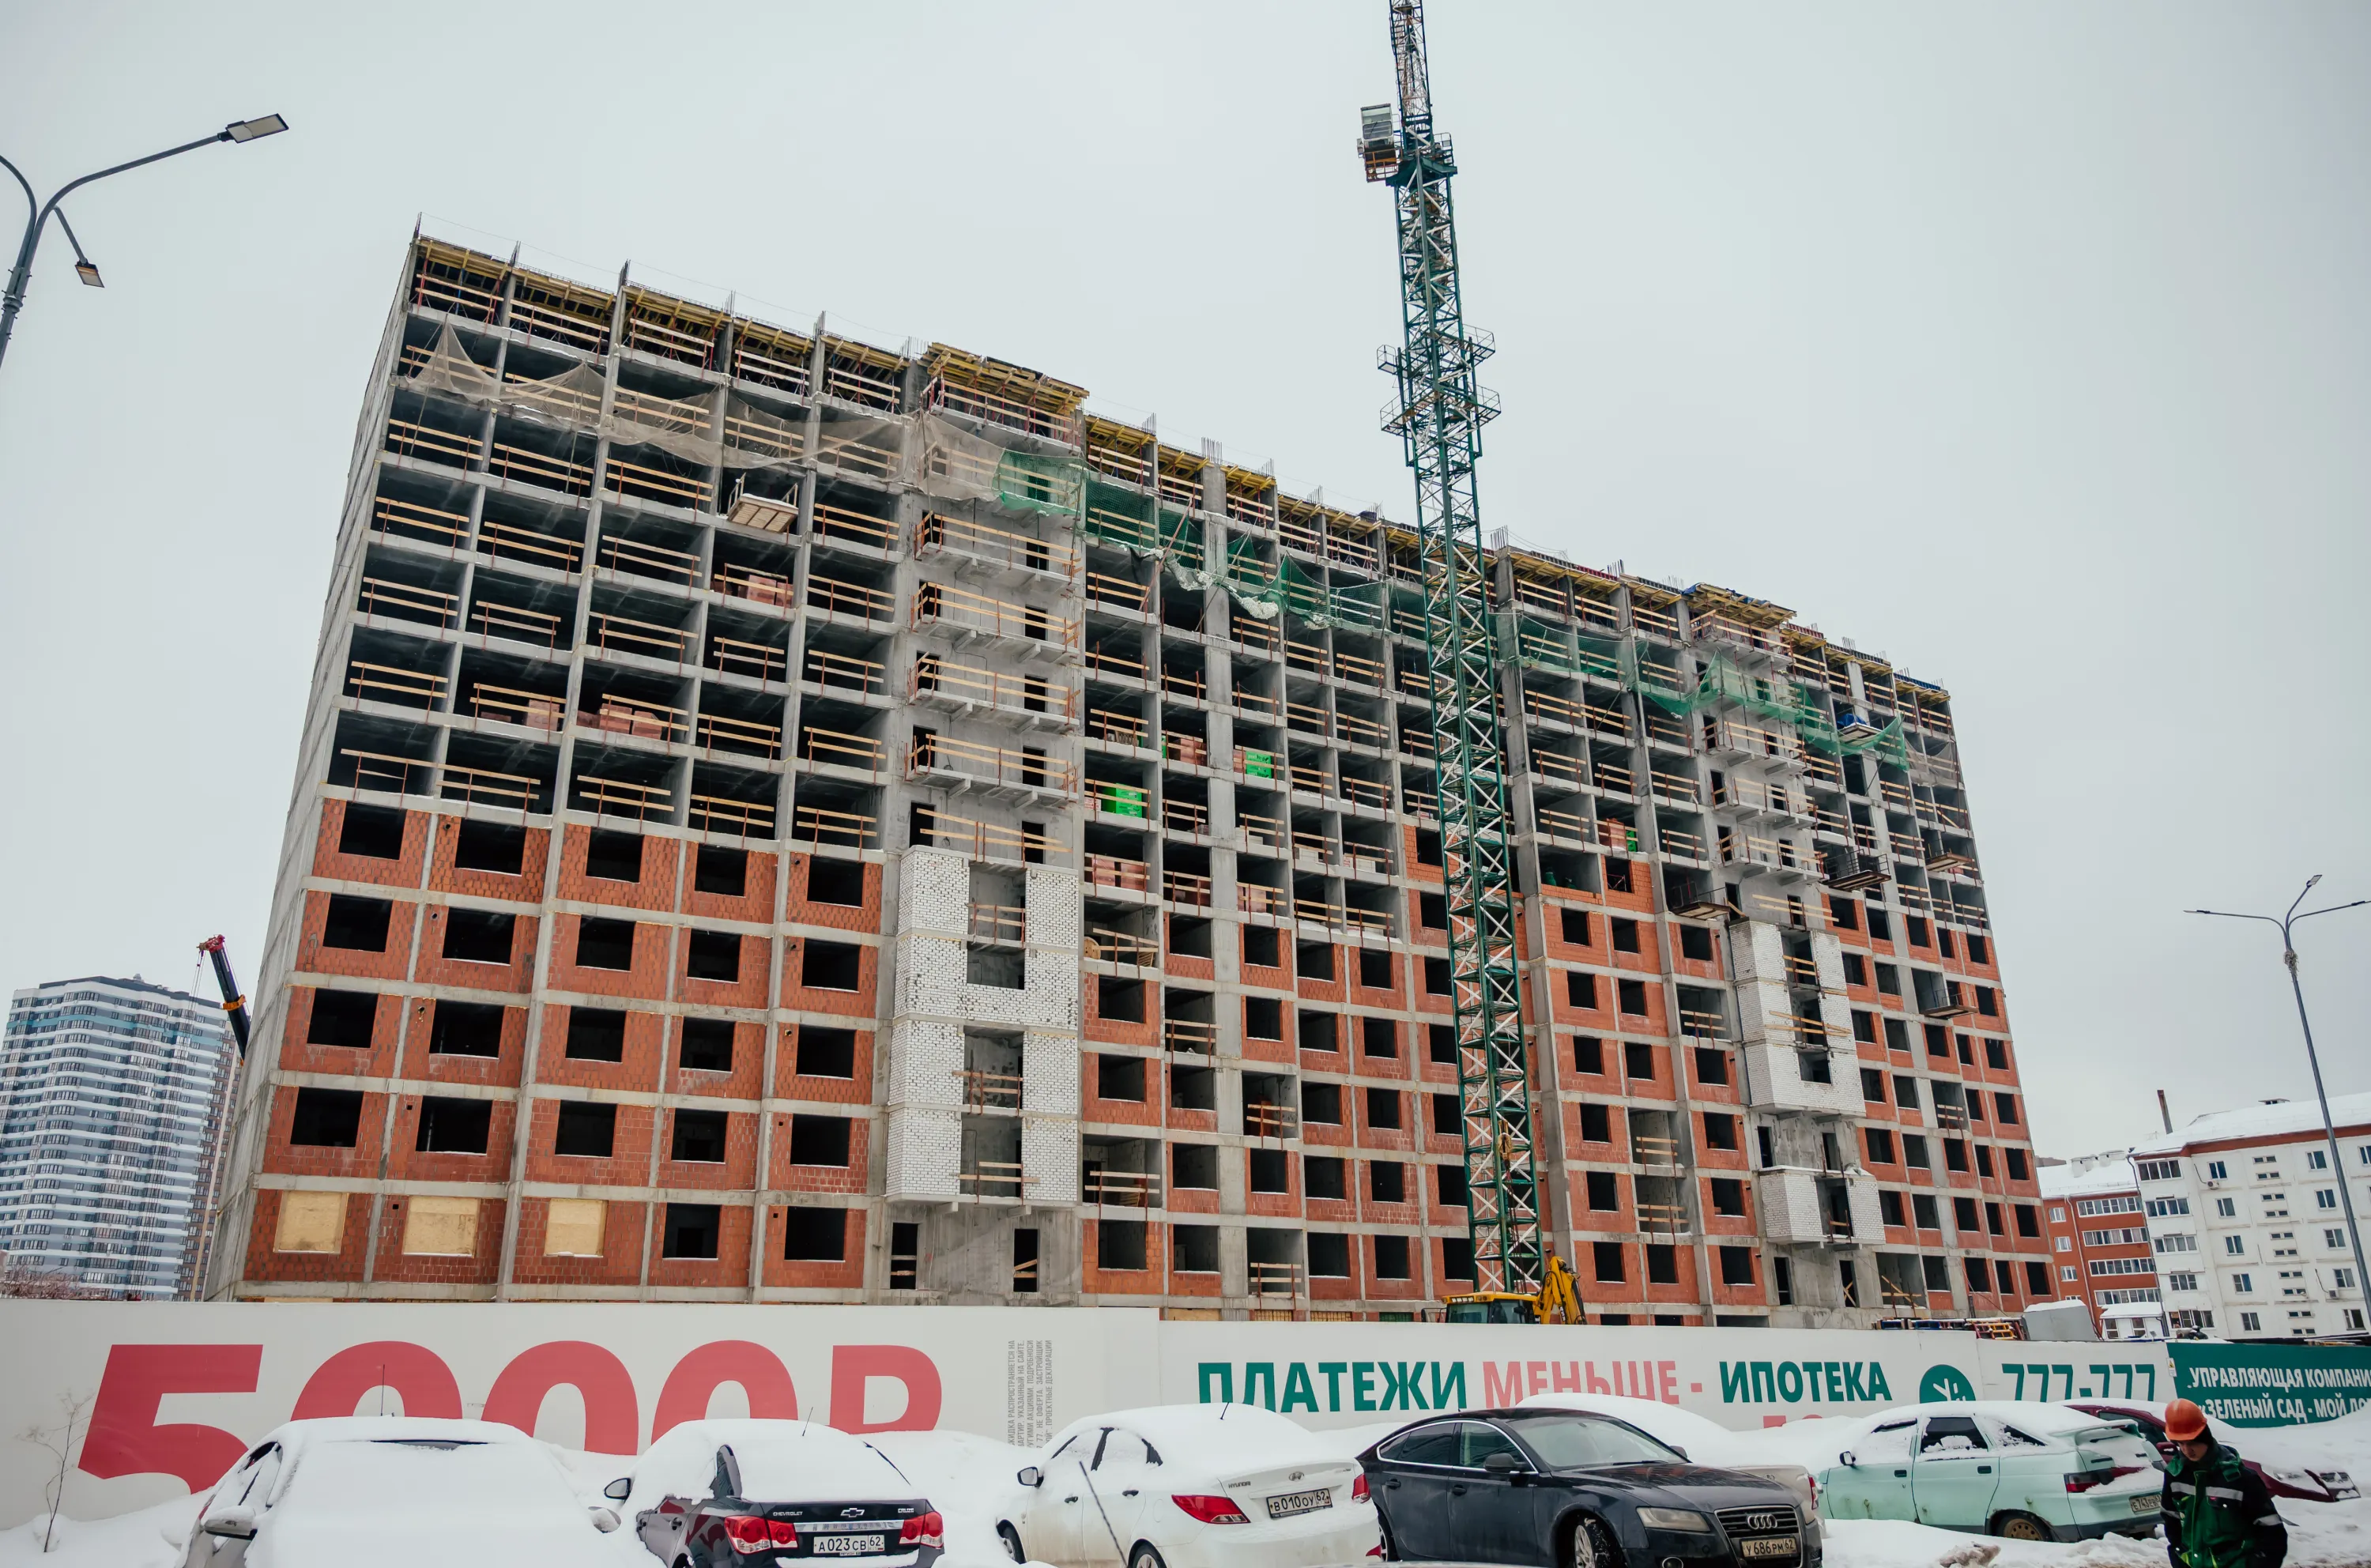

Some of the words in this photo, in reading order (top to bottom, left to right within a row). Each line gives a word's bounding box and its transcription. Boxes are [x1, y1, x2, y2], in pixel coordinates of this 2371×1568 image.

[1008, 1340, 1015, 1349] НА
[1017, 1365, 1025, 1374] НА
[1035, 1340, 1044, 1385] ЗАСТРОЙЩИК
[1197, 1361, 1467, 1413] ПЛАТЕЖИ
[1482, 1360, 1680, 1409] МЕНЬШЕ
[1718, 1360, 1893, 1403] ИПОТЕКА
[2001, 1363, 2155, 1403] 777-777
[2188, 1367, 2305, 1393] УПРАВЛЯЮЩАЯ
[2305, 1368, 2371, 1389] КОМПАНИ
[1016, 1376, 1025, 1419] УКАЗАННЫЙ
[2277, 1398, 2308, 1423] САД
[2313, 1393, 2347, 1418] МОЙ
[1036, 1419, 1043, 1428] НЕ
[1227, 1480, 1251, 1489] HYUNDAI
[1274, 1494, 1314, 1512] В010ОУ
[1316, 1491, 1326, 1502] 62
[818, 1537, 867, 1552] А023СВ
[869, 1536, 881, 1547] 62
[1746, 1541, 1784, 1556] У686РМ
[1785, 1539, 1793, 1549] 62
